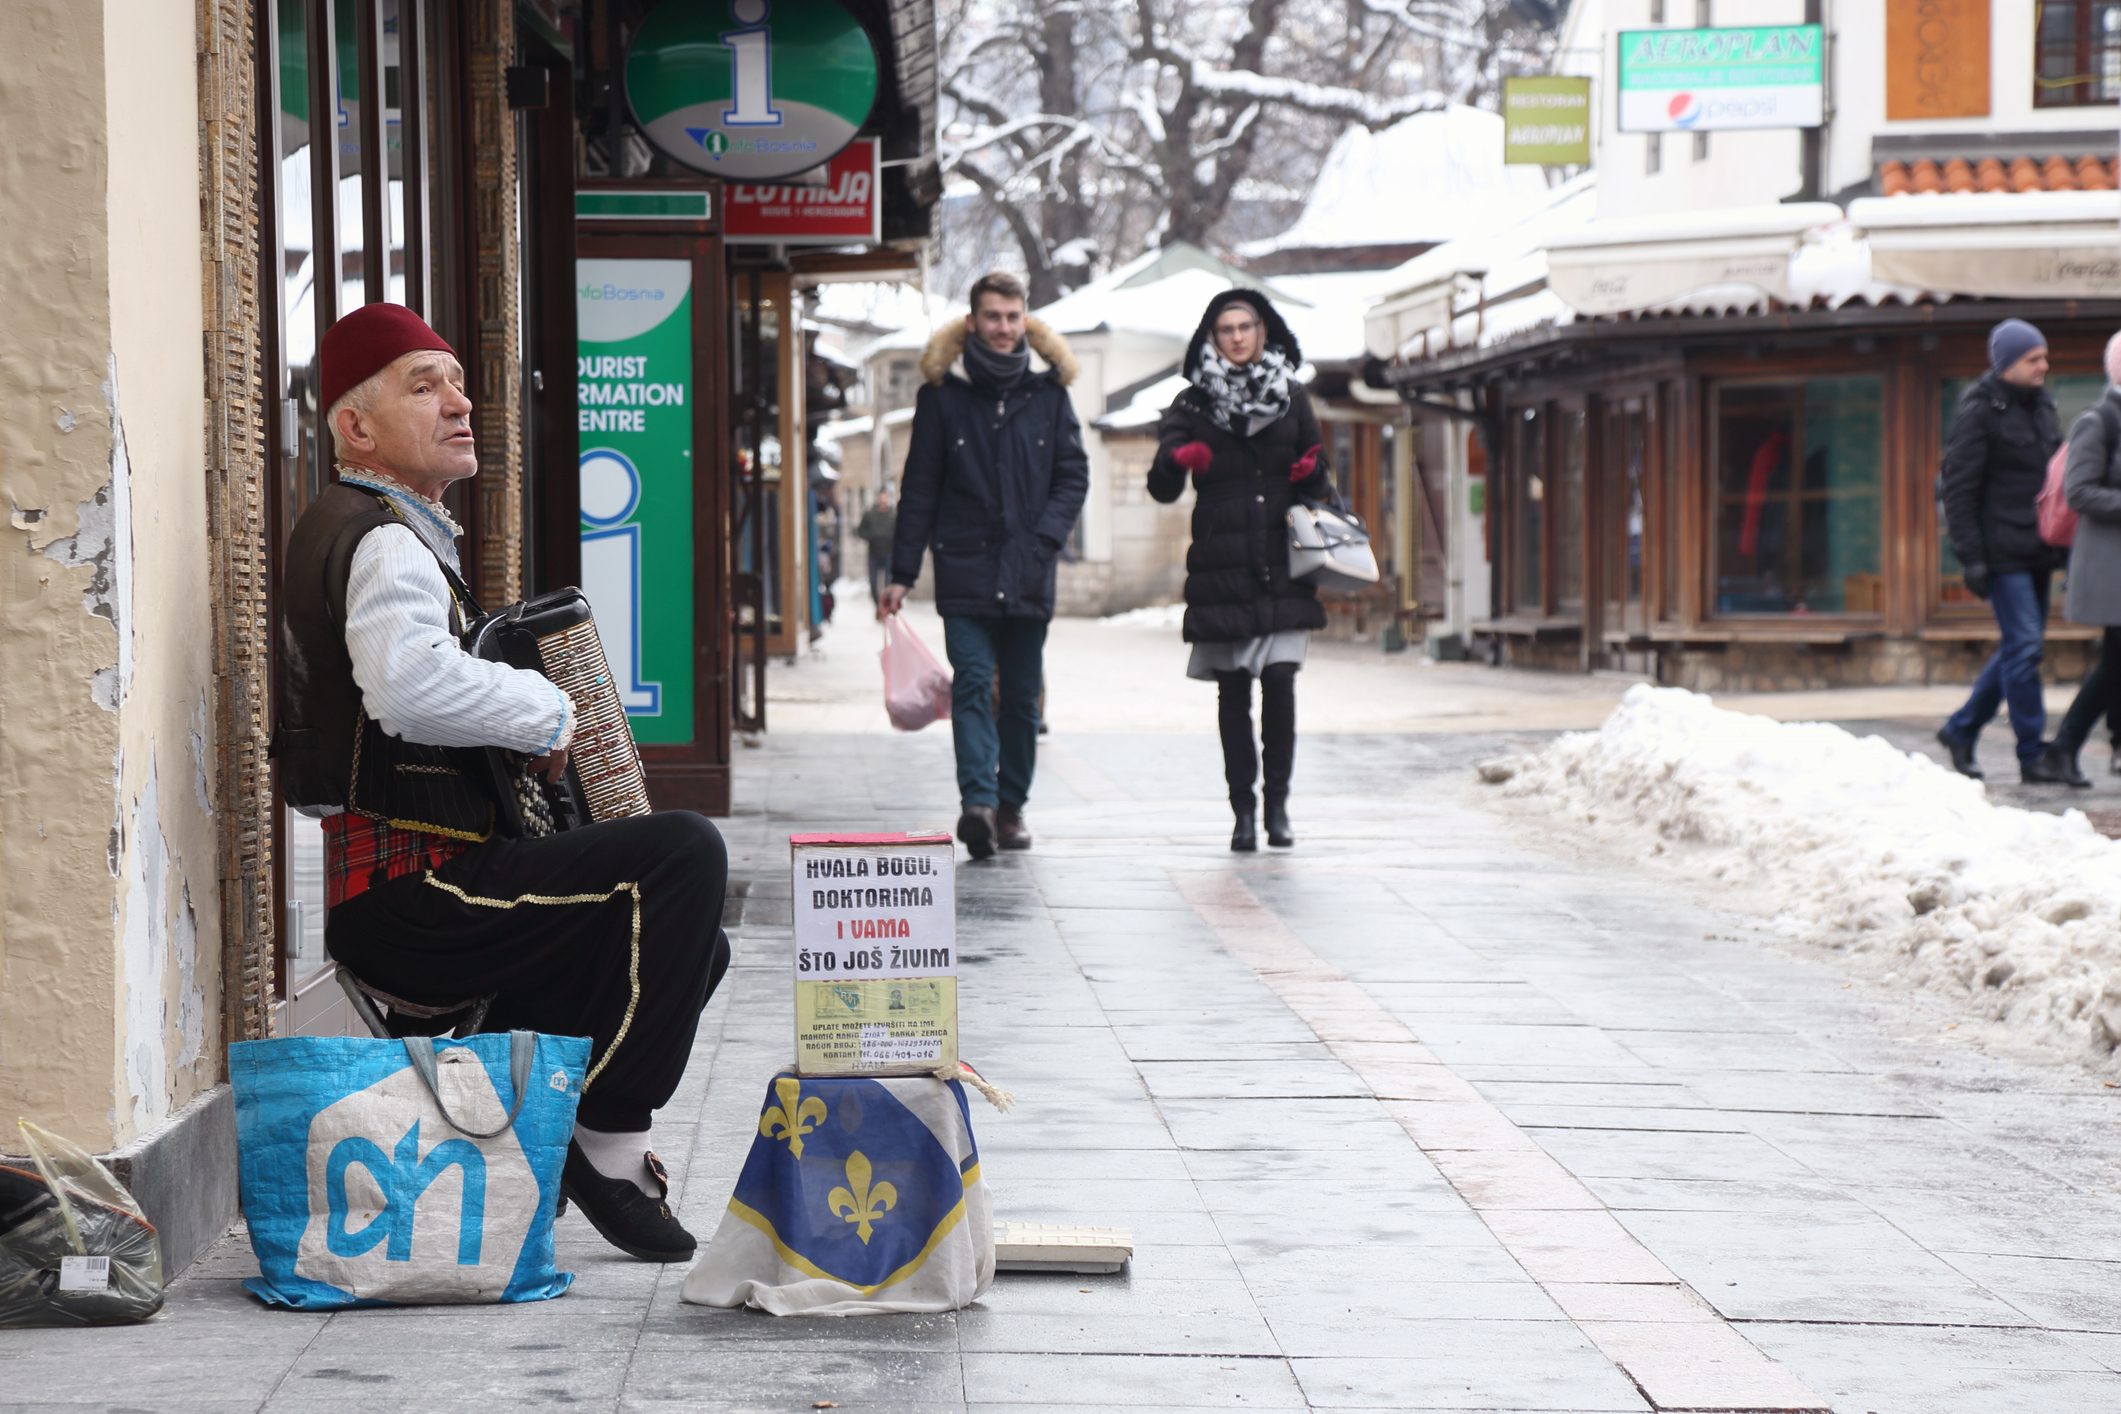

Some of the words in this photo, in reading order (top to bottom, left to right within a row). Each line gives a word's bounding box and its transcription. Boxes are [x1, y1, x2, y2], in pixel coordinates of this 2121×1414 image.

[1627, 28, 1816, 65] AEROPLAN
[1707, 96, 1777, 118] pepsi
[806, 857, 869, 879] HVALA
[876, 855, 938, 877] BOGU,
[812, 886, 933, 910] DOKTORIMA
[837, 920, 844, 940] I
[850, 918, 911, 940] VAMA
[799, 948, 836, 972] ŠTO
[843, 946, 883, 970] JOŠ
[890, 945, 950, 969] ŽIVIM
[812, 1023, 840, 1032] UPLATE
[842, 1021, 872, 1030] MOŽETE
[920, 1020, 936, 1028] IME
[920, 1029, 948, 1037] ZENICA
[823, 1051, 857, 1059] KONTAKT
